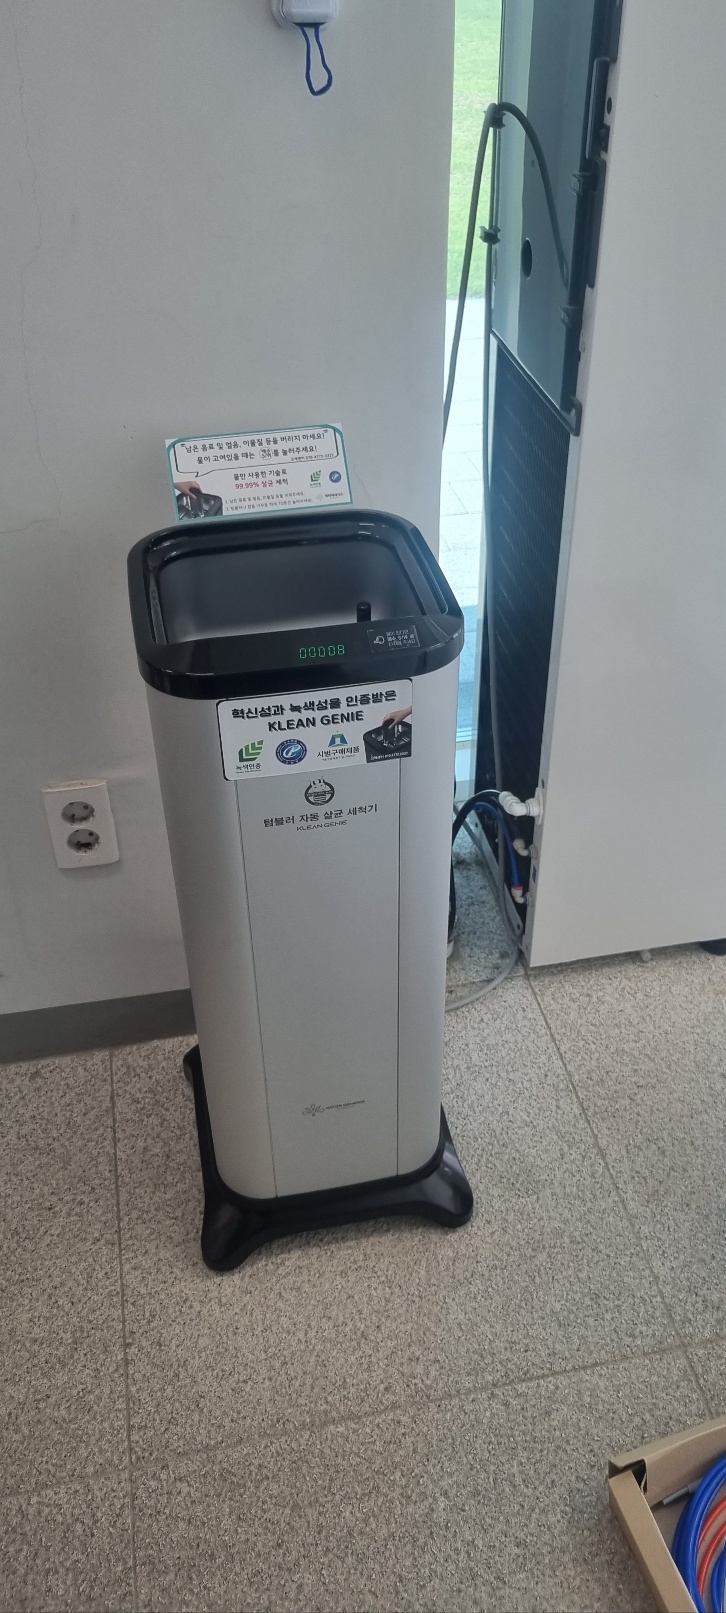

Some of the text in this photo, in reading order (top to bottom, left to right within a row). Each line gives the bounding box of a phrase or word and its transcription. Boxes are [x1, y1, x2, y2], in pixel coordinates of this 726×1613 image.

[201, 443, 215, 452] 음료
[217, 442, 223, 451] 및
[243, 438, 263, 447] 이물질
[266, 437, 278, 446] 등을
[280, 434, 300, 443] 버리지
[197, 451, 255, 465] 물이 고여있을 때는
[233, 468, 288, 481] 물만 사용한 기술로
[235, 478, 289, 490] 99.99% 살균 세척
[299, 644, 345, 659] 00008
[231, 689, 397, 720] 혁신성과 녹색성을 인증받은
[268, 710, 365, 732] KLEAN GENIE
[316, 745, 360, 758] 시범구매제품
[236, 763, 262, 771] 녹색인증
[263, 803, 378, 828] 텀블러 자동 살균 세척기
[296, 819, 348, 832] KLEAN GENIE
